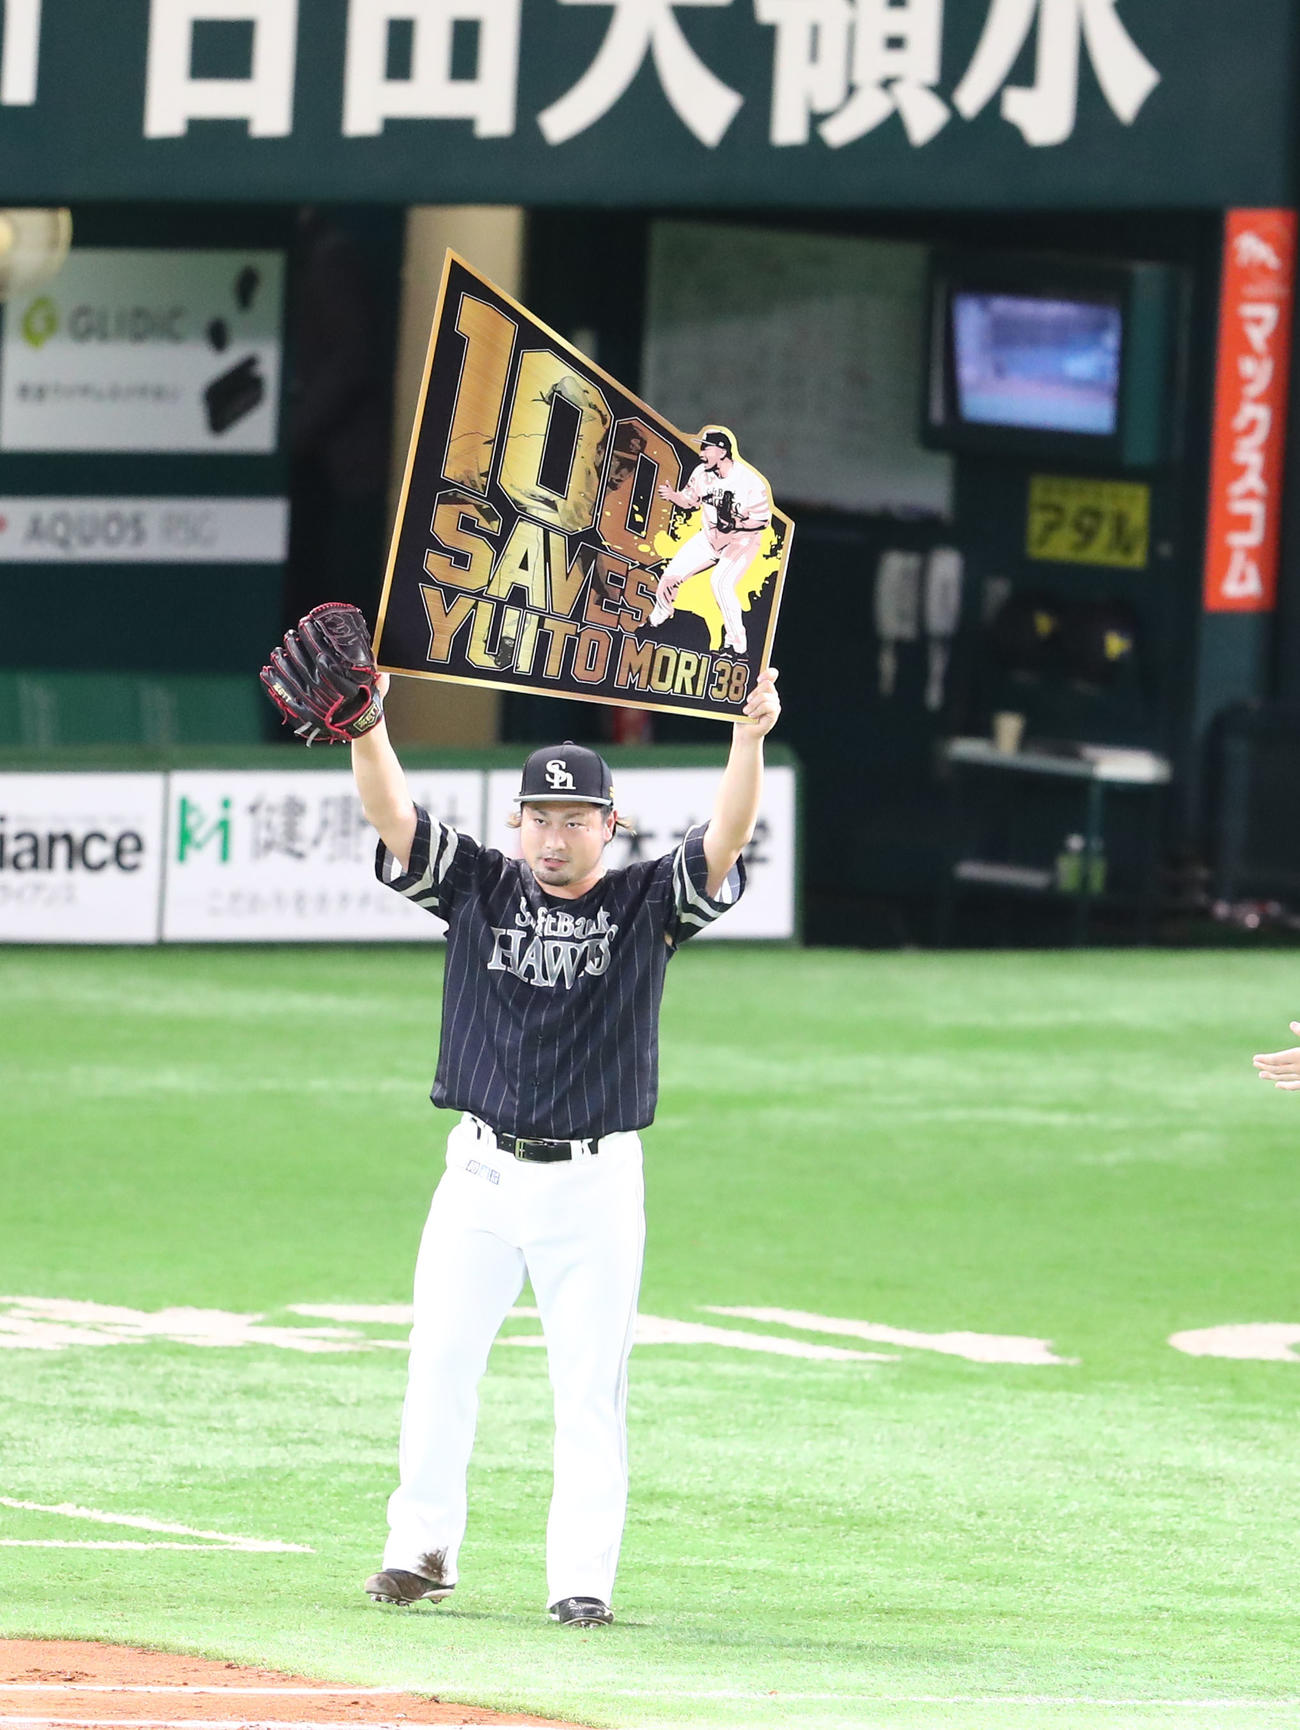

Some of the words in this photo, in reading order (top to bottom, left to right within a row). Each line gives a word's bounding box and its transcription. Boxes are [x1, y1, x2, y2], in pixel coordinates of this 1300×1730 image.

[441, 291, 684, 566] 100
[1220, 303, 1280, 600] マックスコム
[423, 488, 660, 634] SAVES
[418, 583, 613, 685] YUITO
[614, 637, 711, 699] MORI
[708, 655, 750, 704] 38
[487, 924, 619, 990] HAWS
[514, 896, 611, 938] SftBank
